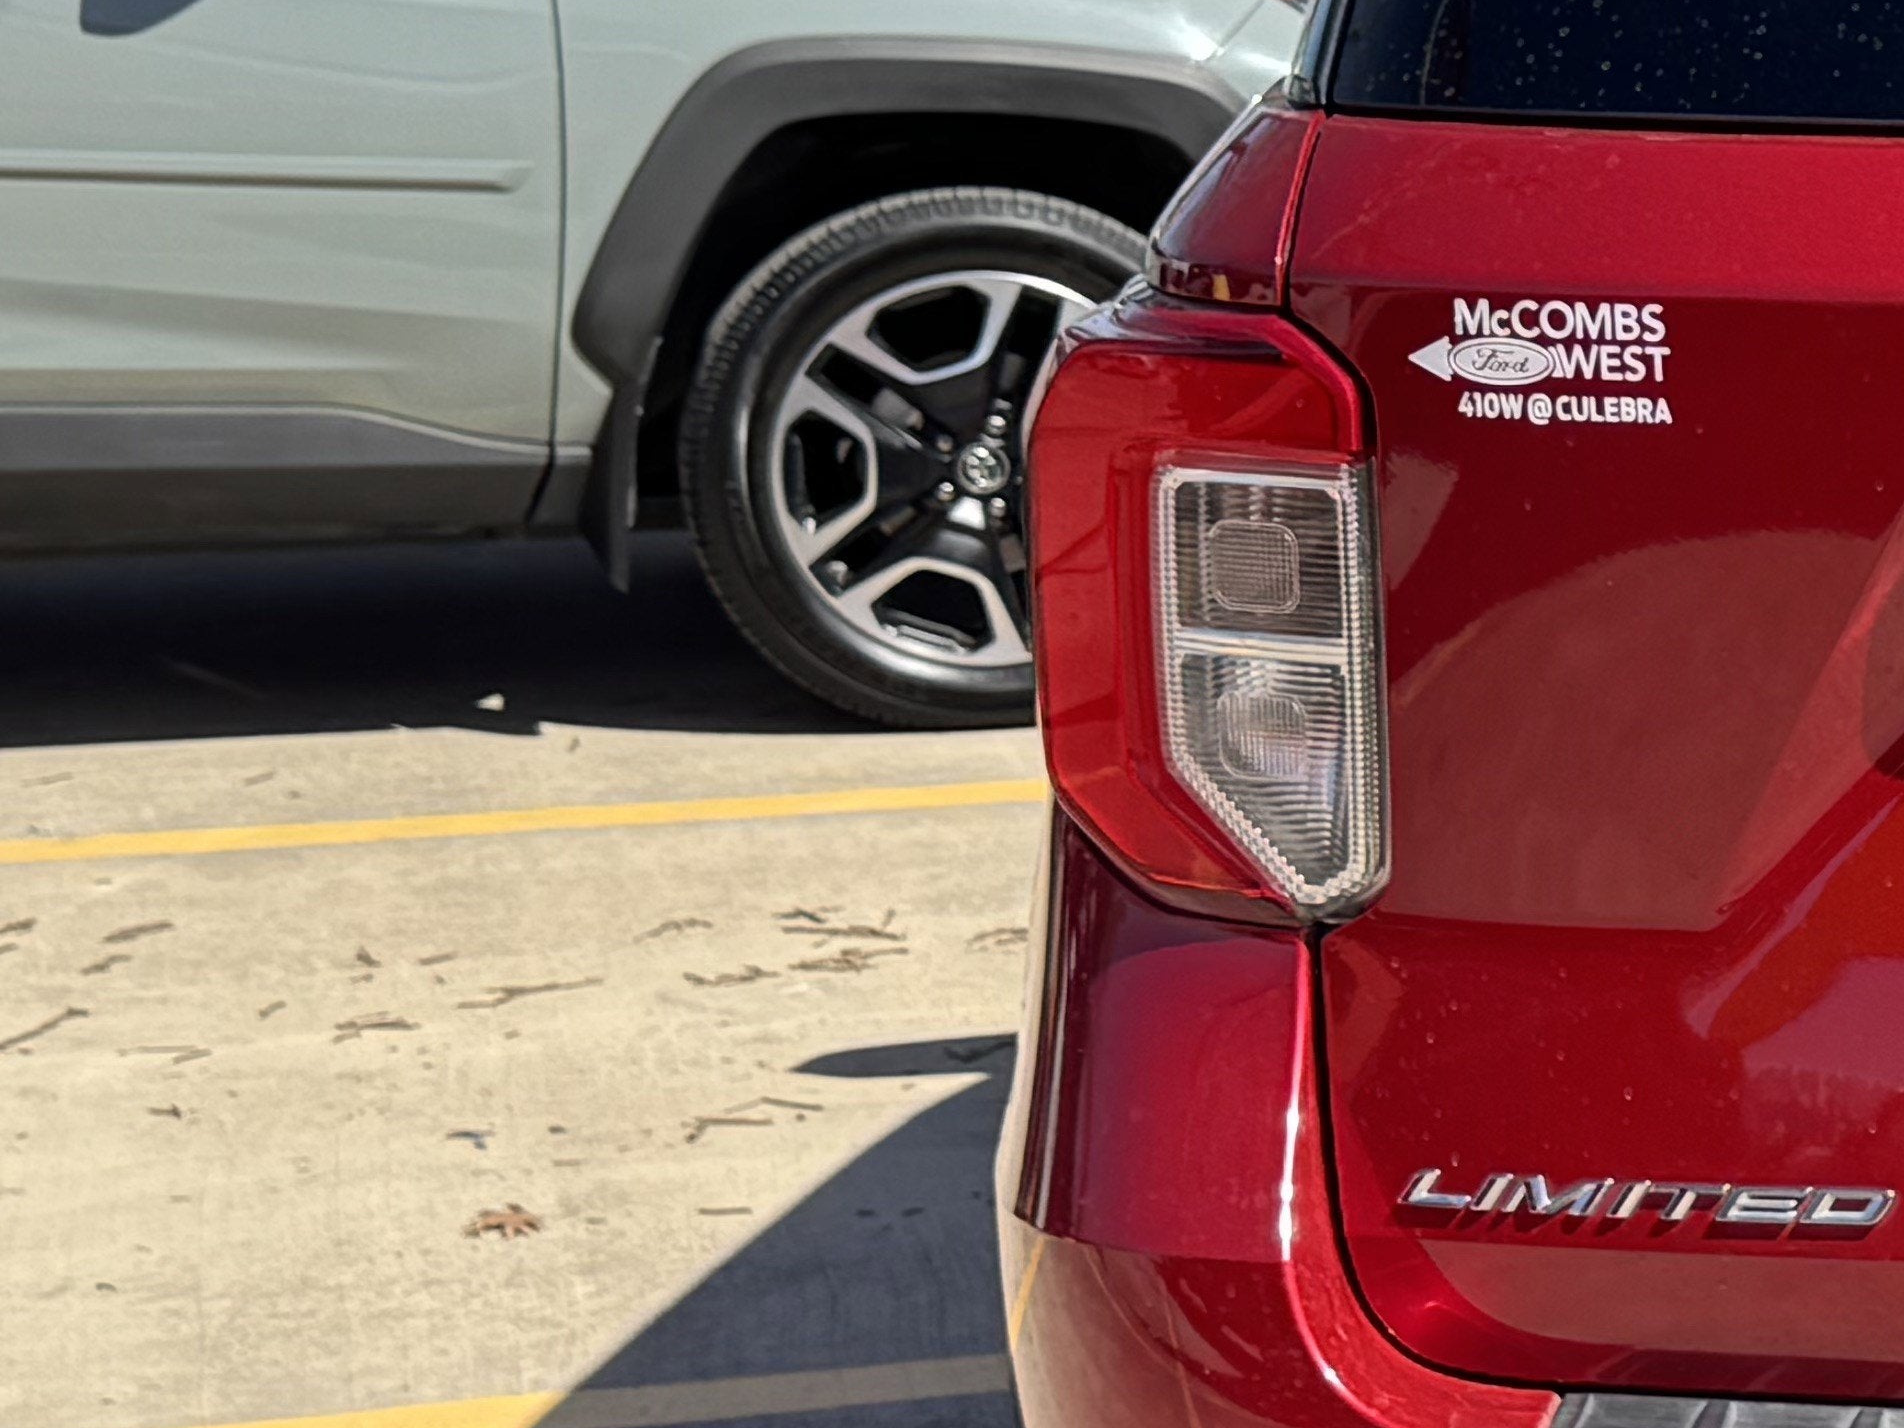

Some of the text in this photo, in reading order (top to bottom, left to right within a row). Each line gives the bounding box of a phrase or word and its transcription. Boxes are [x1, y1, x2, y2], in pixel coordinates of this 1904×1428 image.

[1453, 297, 1667, 343] McCOMBS
[1471, 344, 1671, 383] Ford WEST
[1396, 1168, 1896, 1224] LIMITED
